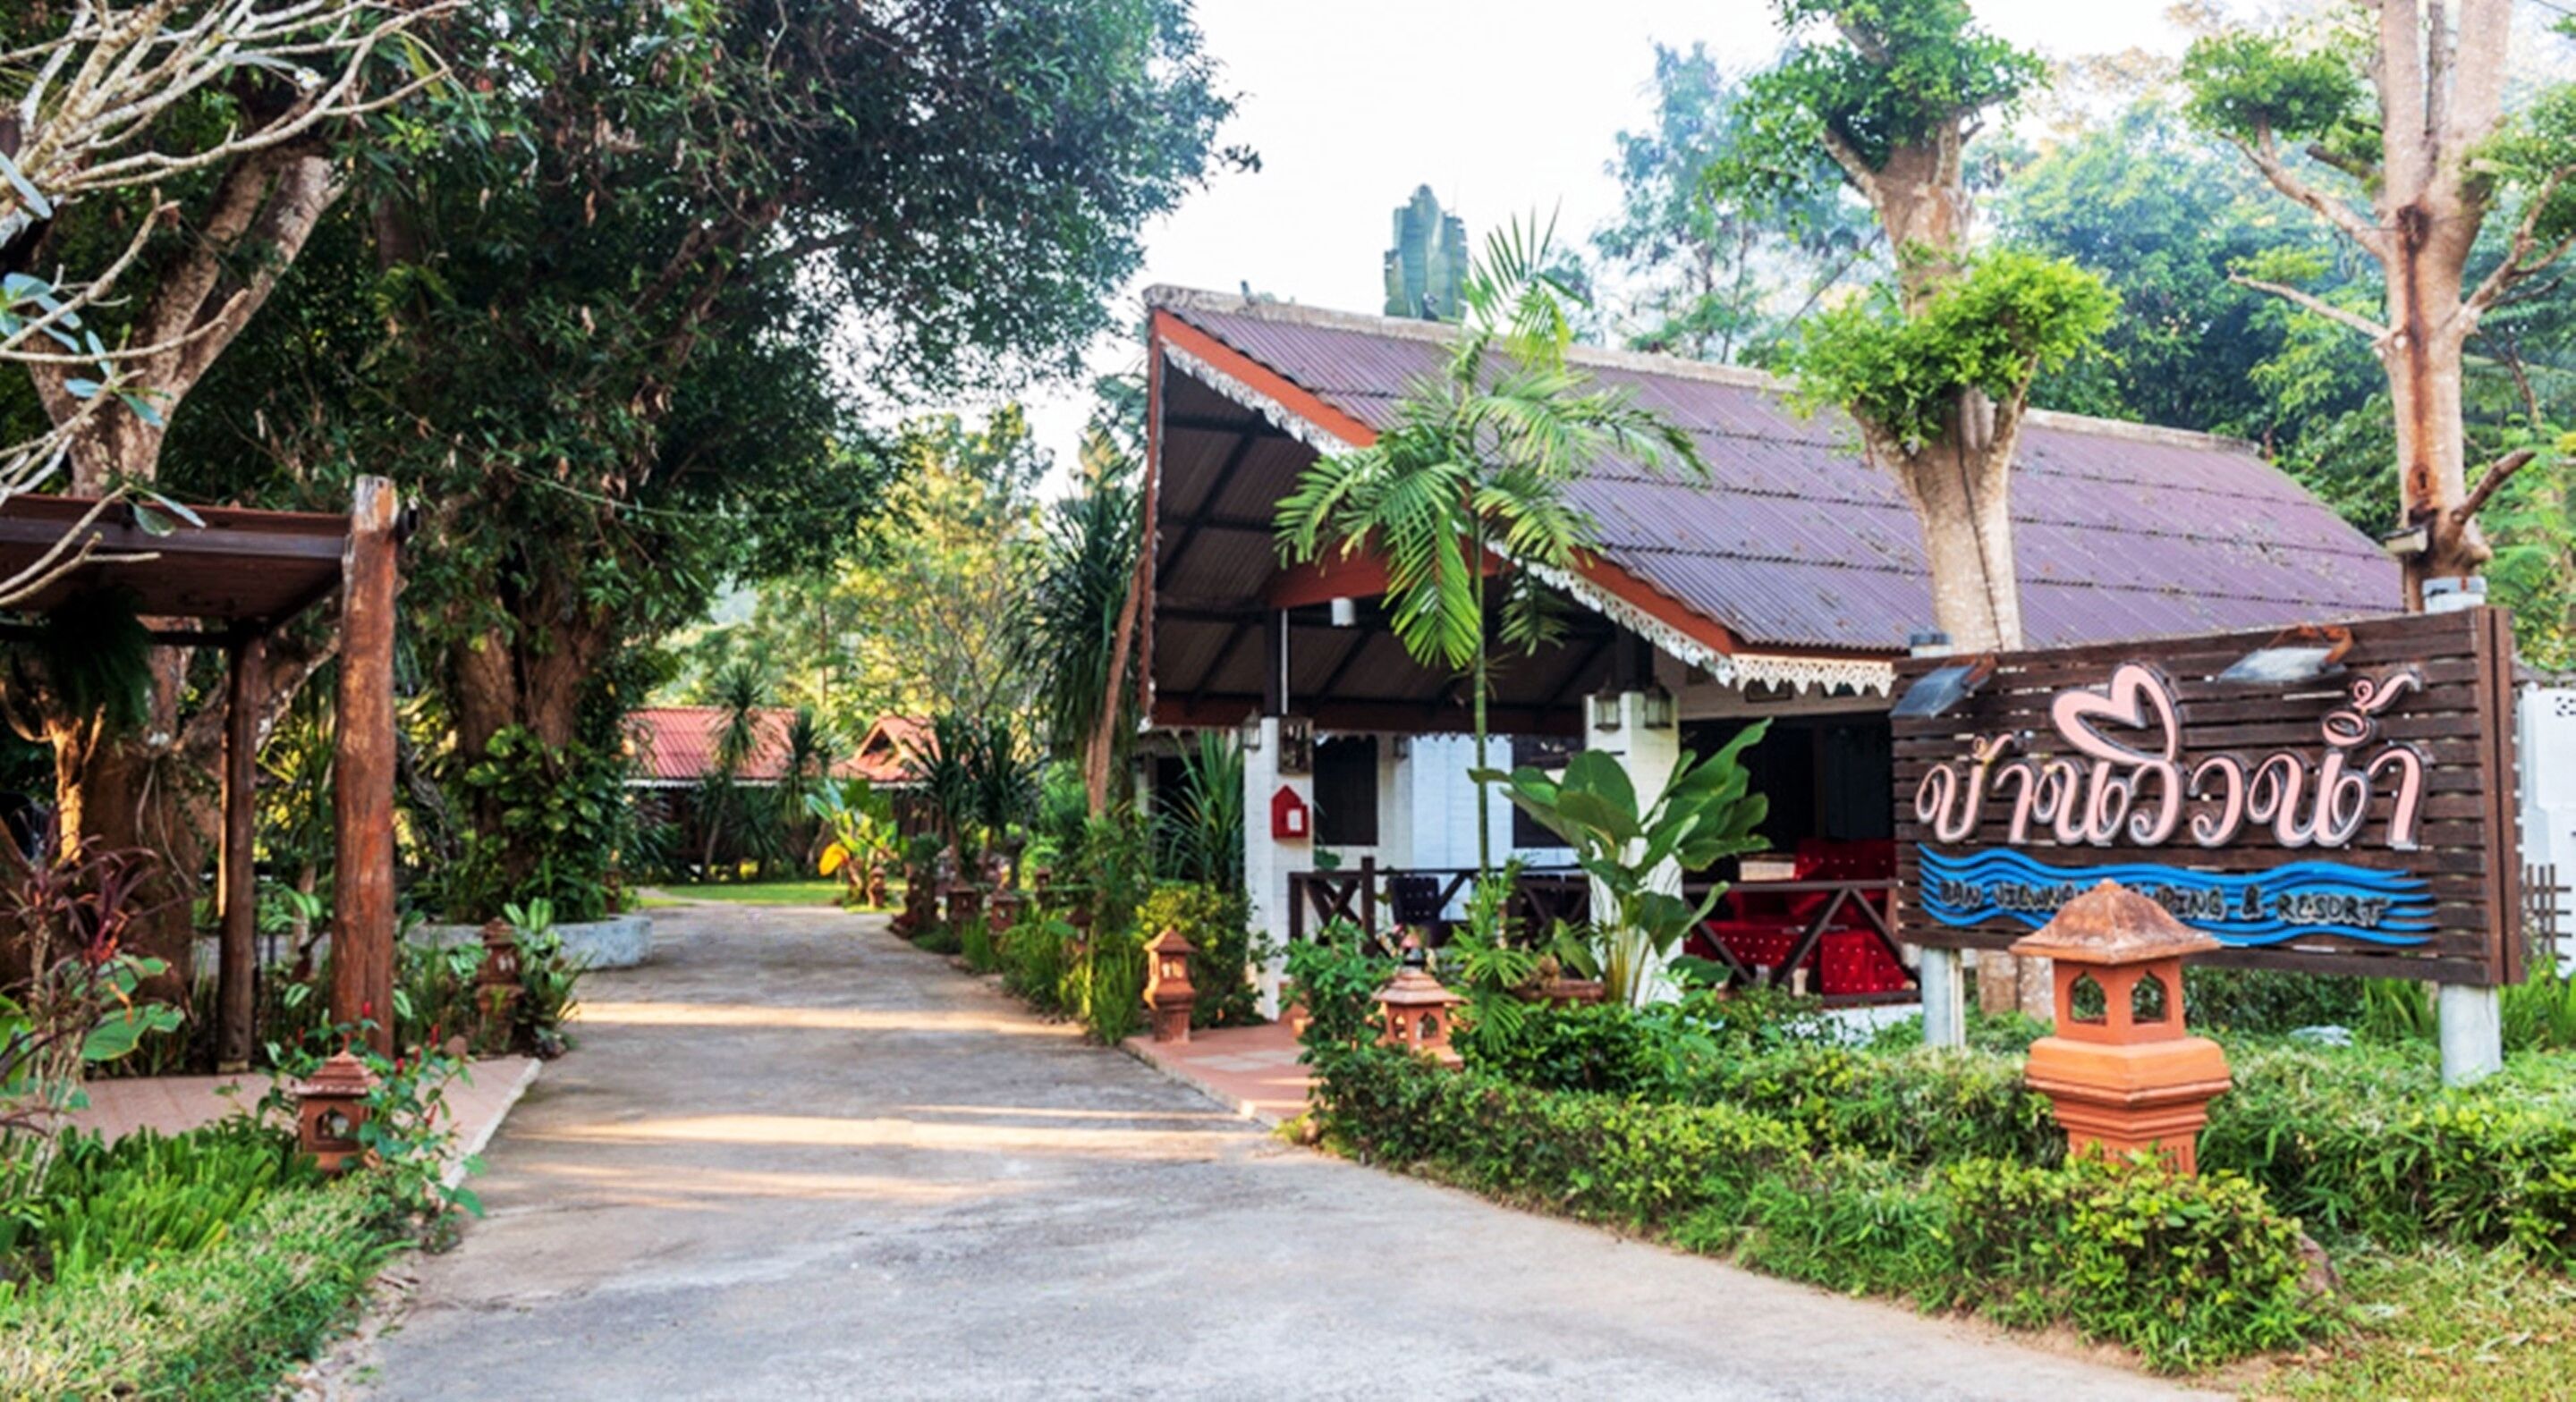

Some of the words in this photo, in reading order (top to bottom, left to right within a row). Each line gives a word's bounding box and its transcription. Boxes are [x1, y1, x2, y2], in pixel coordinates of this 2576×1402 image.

[1915, 662, 2426, 849] บ้านวิวน้ำ
[2242, 883, 2263, 919] &
[2275, 892, 2391, 928] RESORT
